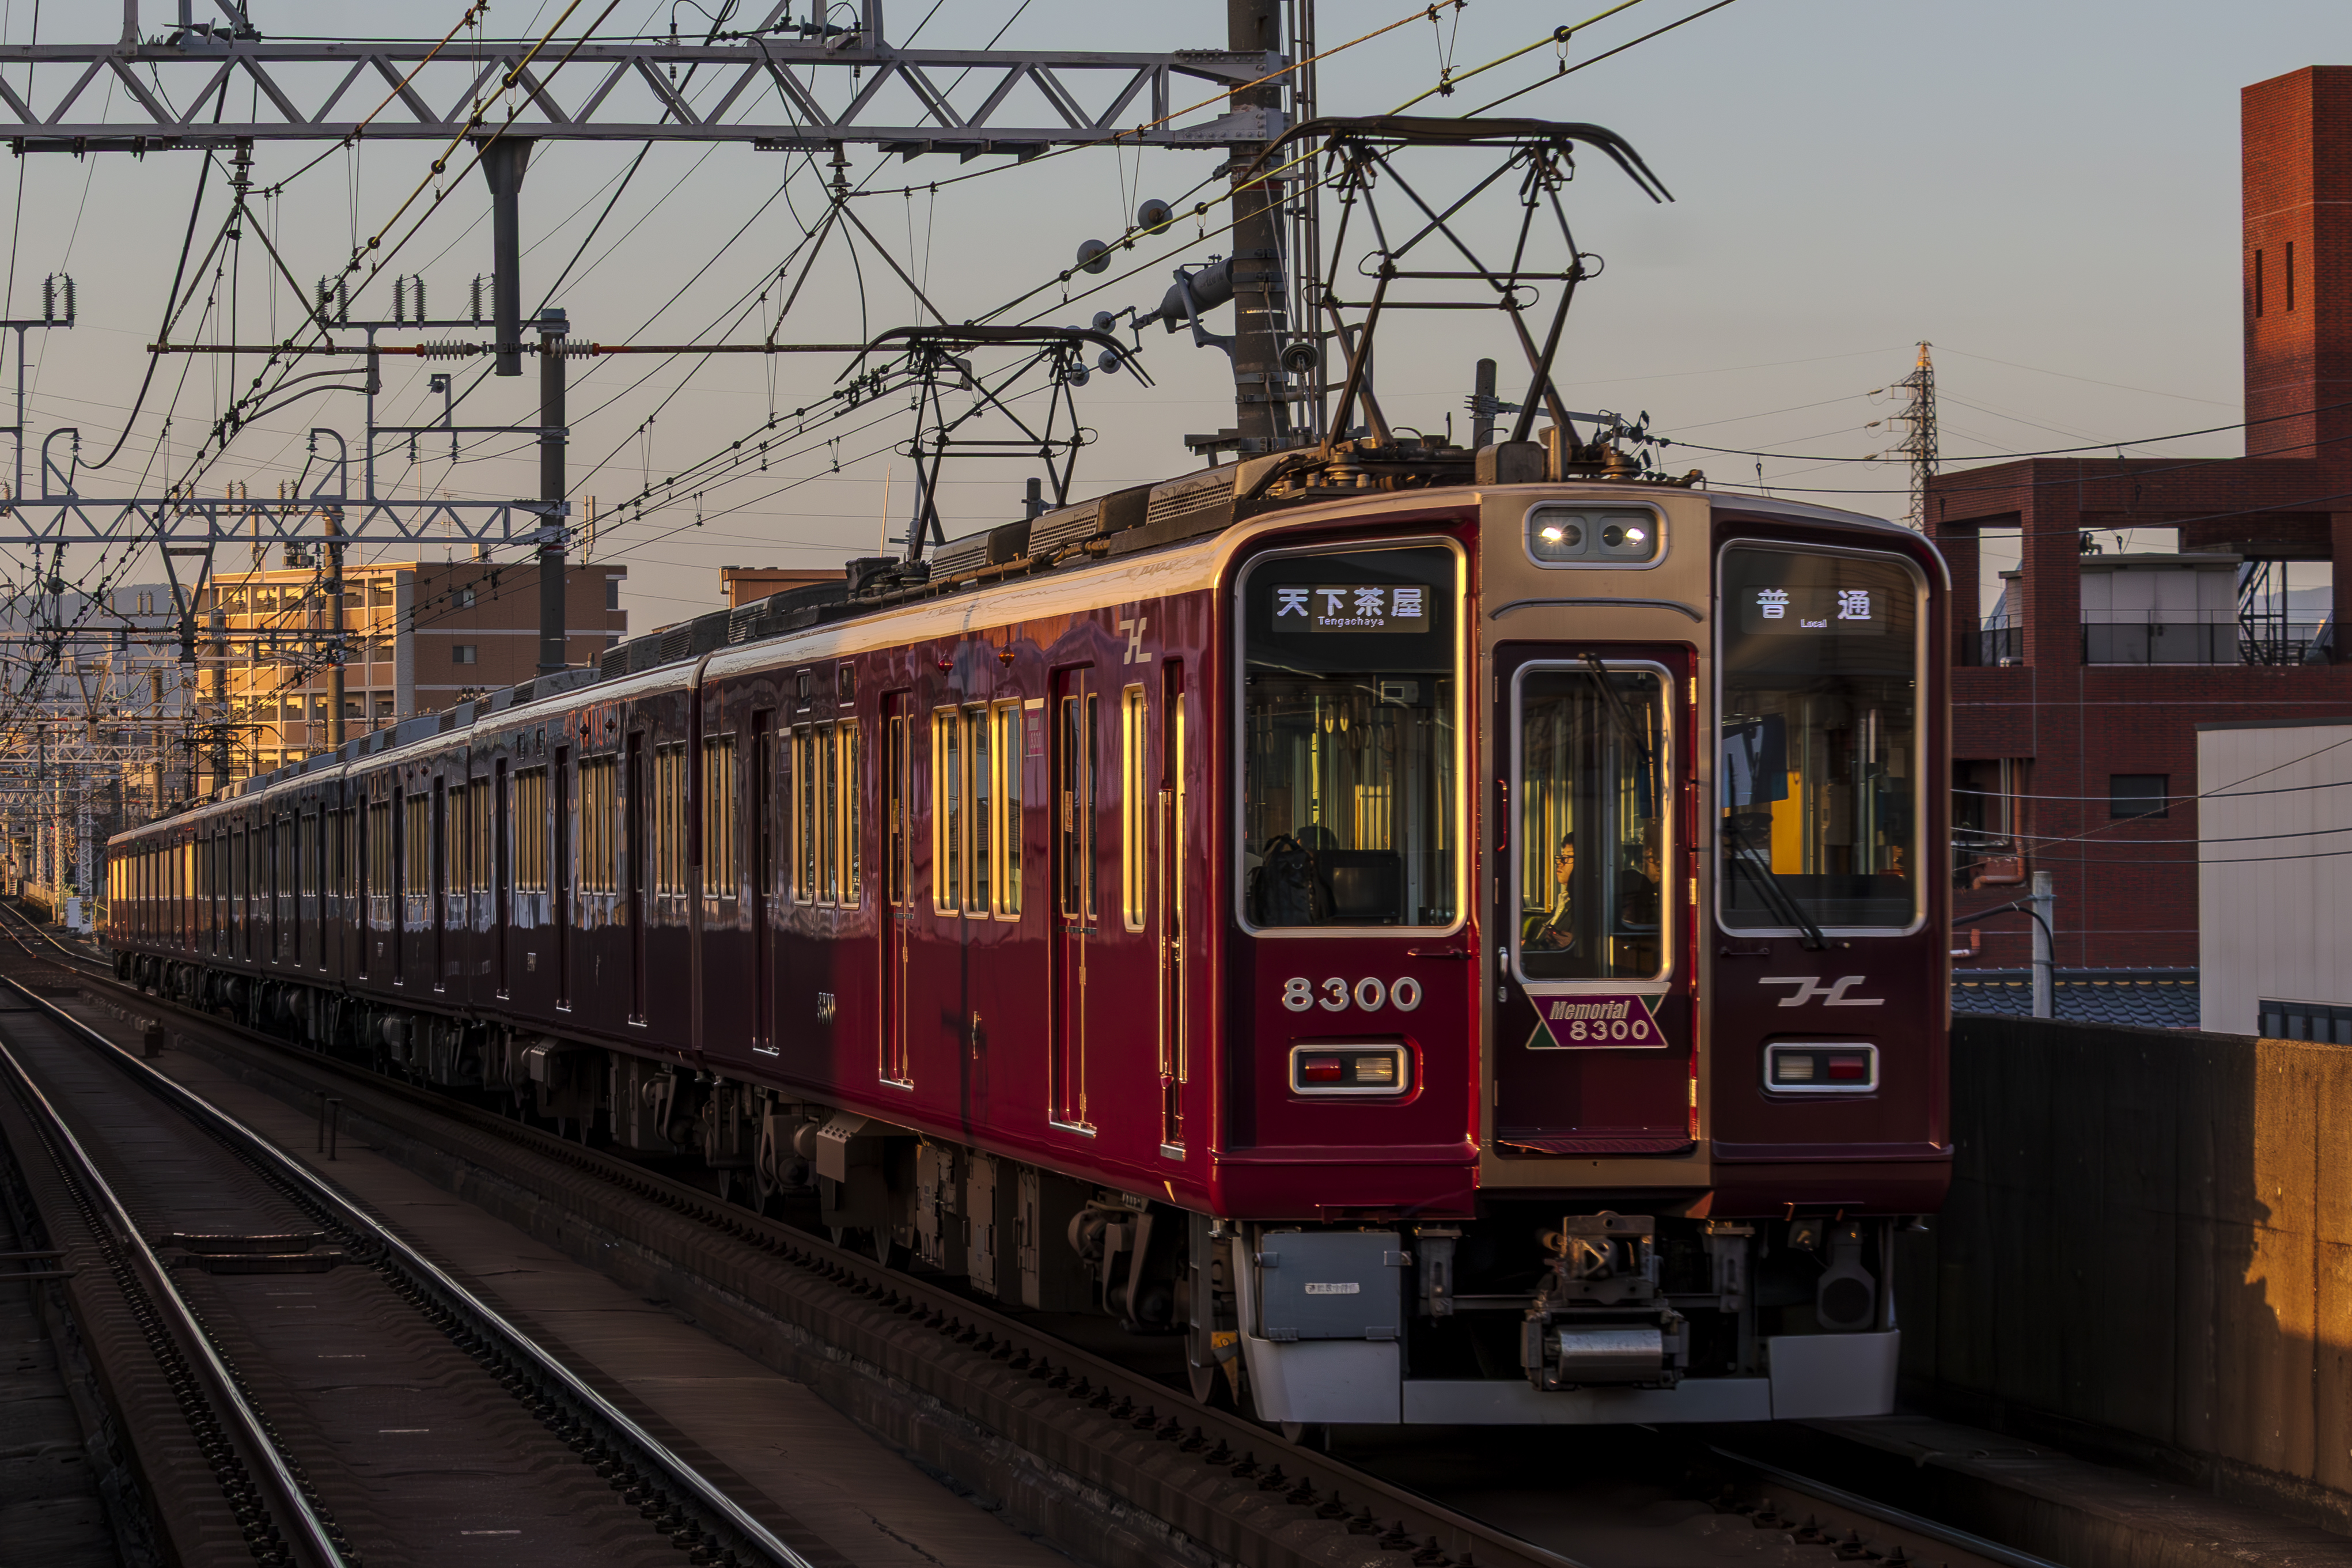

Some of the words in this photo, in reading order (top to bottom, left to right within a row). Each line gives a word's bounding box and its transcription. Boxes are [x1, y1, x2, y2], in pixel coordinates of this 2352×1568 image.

[1277, 587, 1423, 616] 天下茶屋
[1756, 589, 1872, 619] 普通
[1317, 616, 1384, 627] Tengachaya
[1800, 619, 1827, 628] Local
[1282, 976, 1423, 1012] 8300
[1548, 1000, 1631, 1020] Memorial
[1569, 1020, 1650, 1041] 8300
